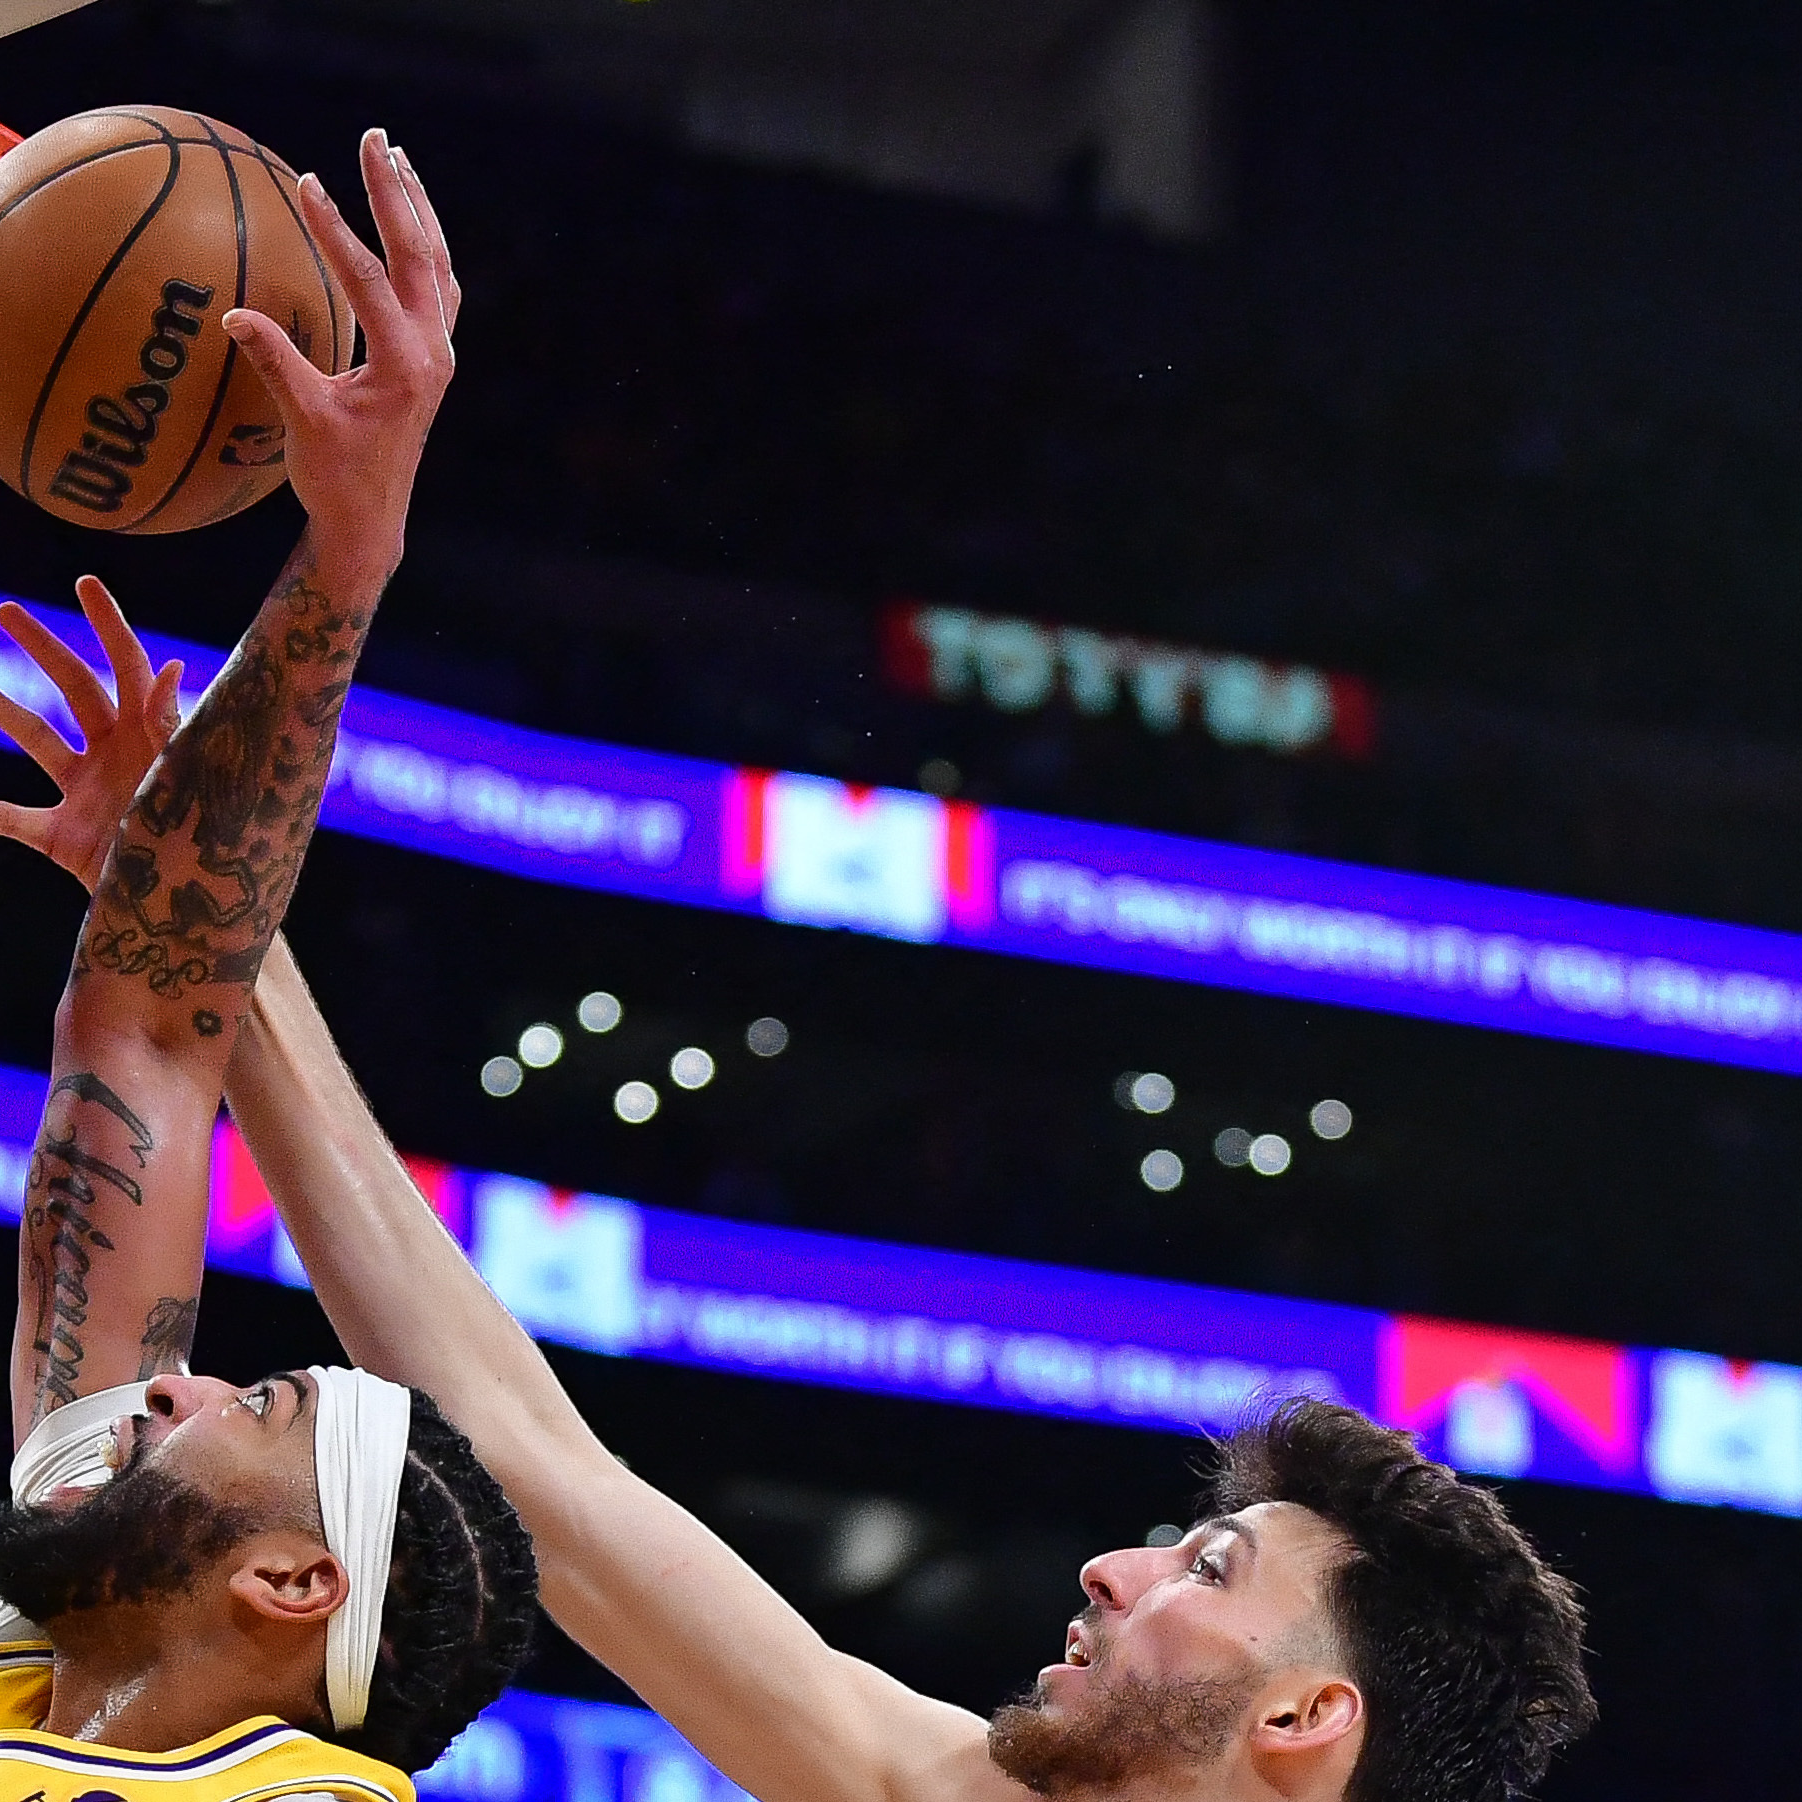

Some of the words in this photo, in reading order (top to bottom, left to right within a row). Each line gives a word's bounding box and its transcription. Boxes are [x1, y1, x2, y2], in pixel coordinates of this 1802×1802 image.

[47, 279, 214, 512] Wilson
[1241, 897, 1417, 980] WORTH
[1530, 940, 1629, 1022] YOU
[1630, 956, 1796, 1044] ENJOY
